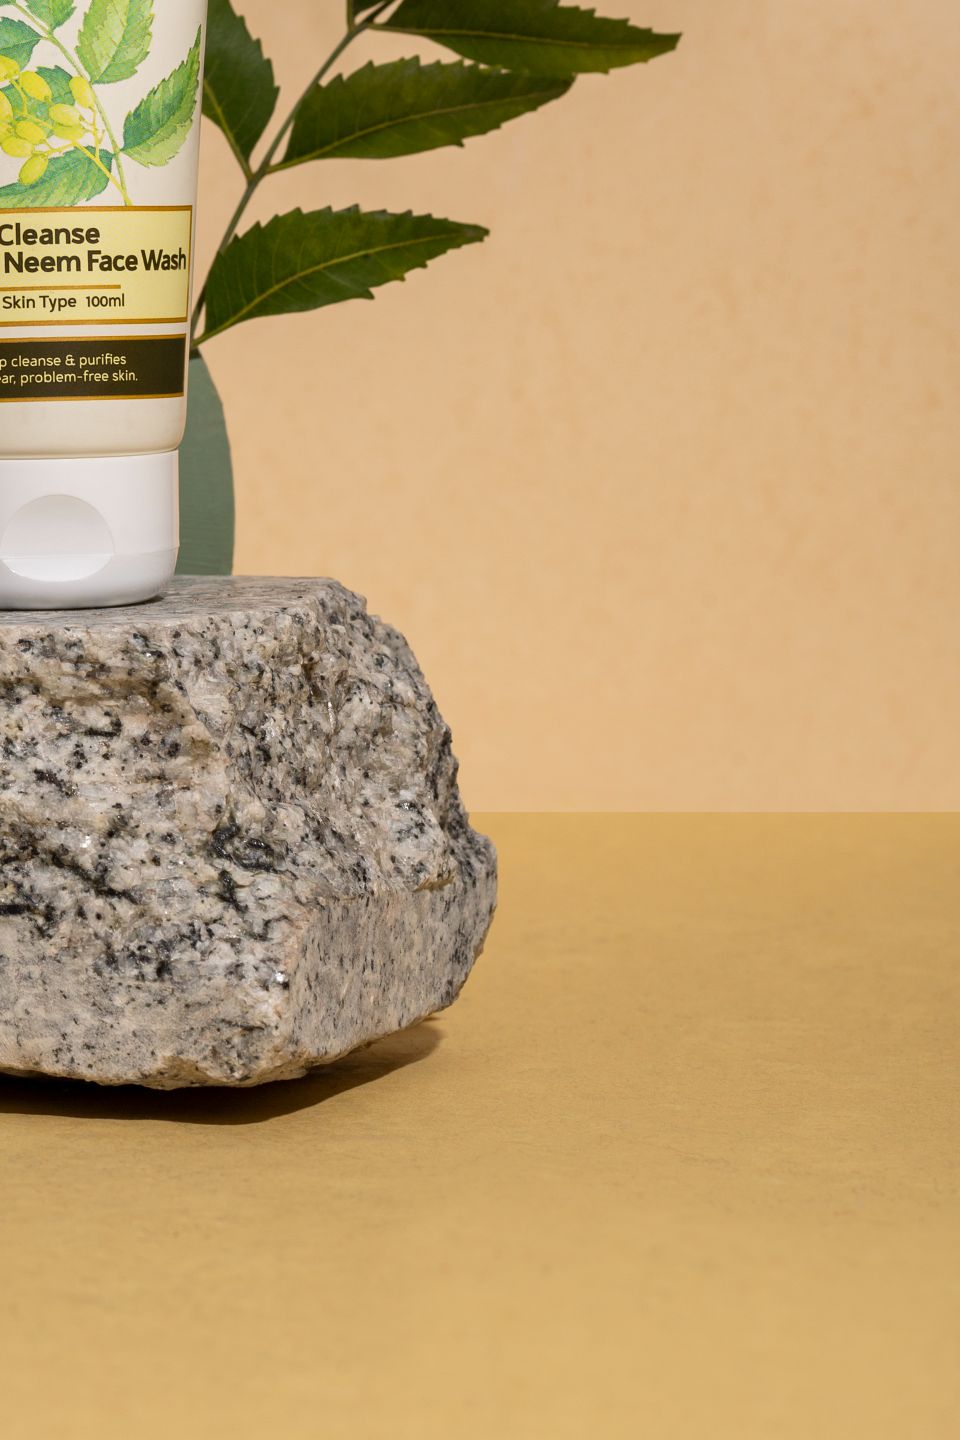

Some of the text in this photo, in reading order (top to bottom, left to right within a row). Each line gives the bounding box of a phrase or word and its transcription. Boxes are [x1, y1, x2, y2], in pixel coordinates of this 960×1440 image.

[4, 252, 81, 274] Neem
[87, 250, 138, 272] Face
[141, 247, 187, 270] Wash
[2, 295, 35, 309] Skin
[39, 295, 77, 312] Type
[85, 293, 125, 308] 100ml
[11, 354, 61, 367] cleanse
[65, 354, 76, 366] &
[79, 353, 126, 368] purifies
[21, 371, 109, 386] problem-free
[112, 370, 138, 382] skin.
